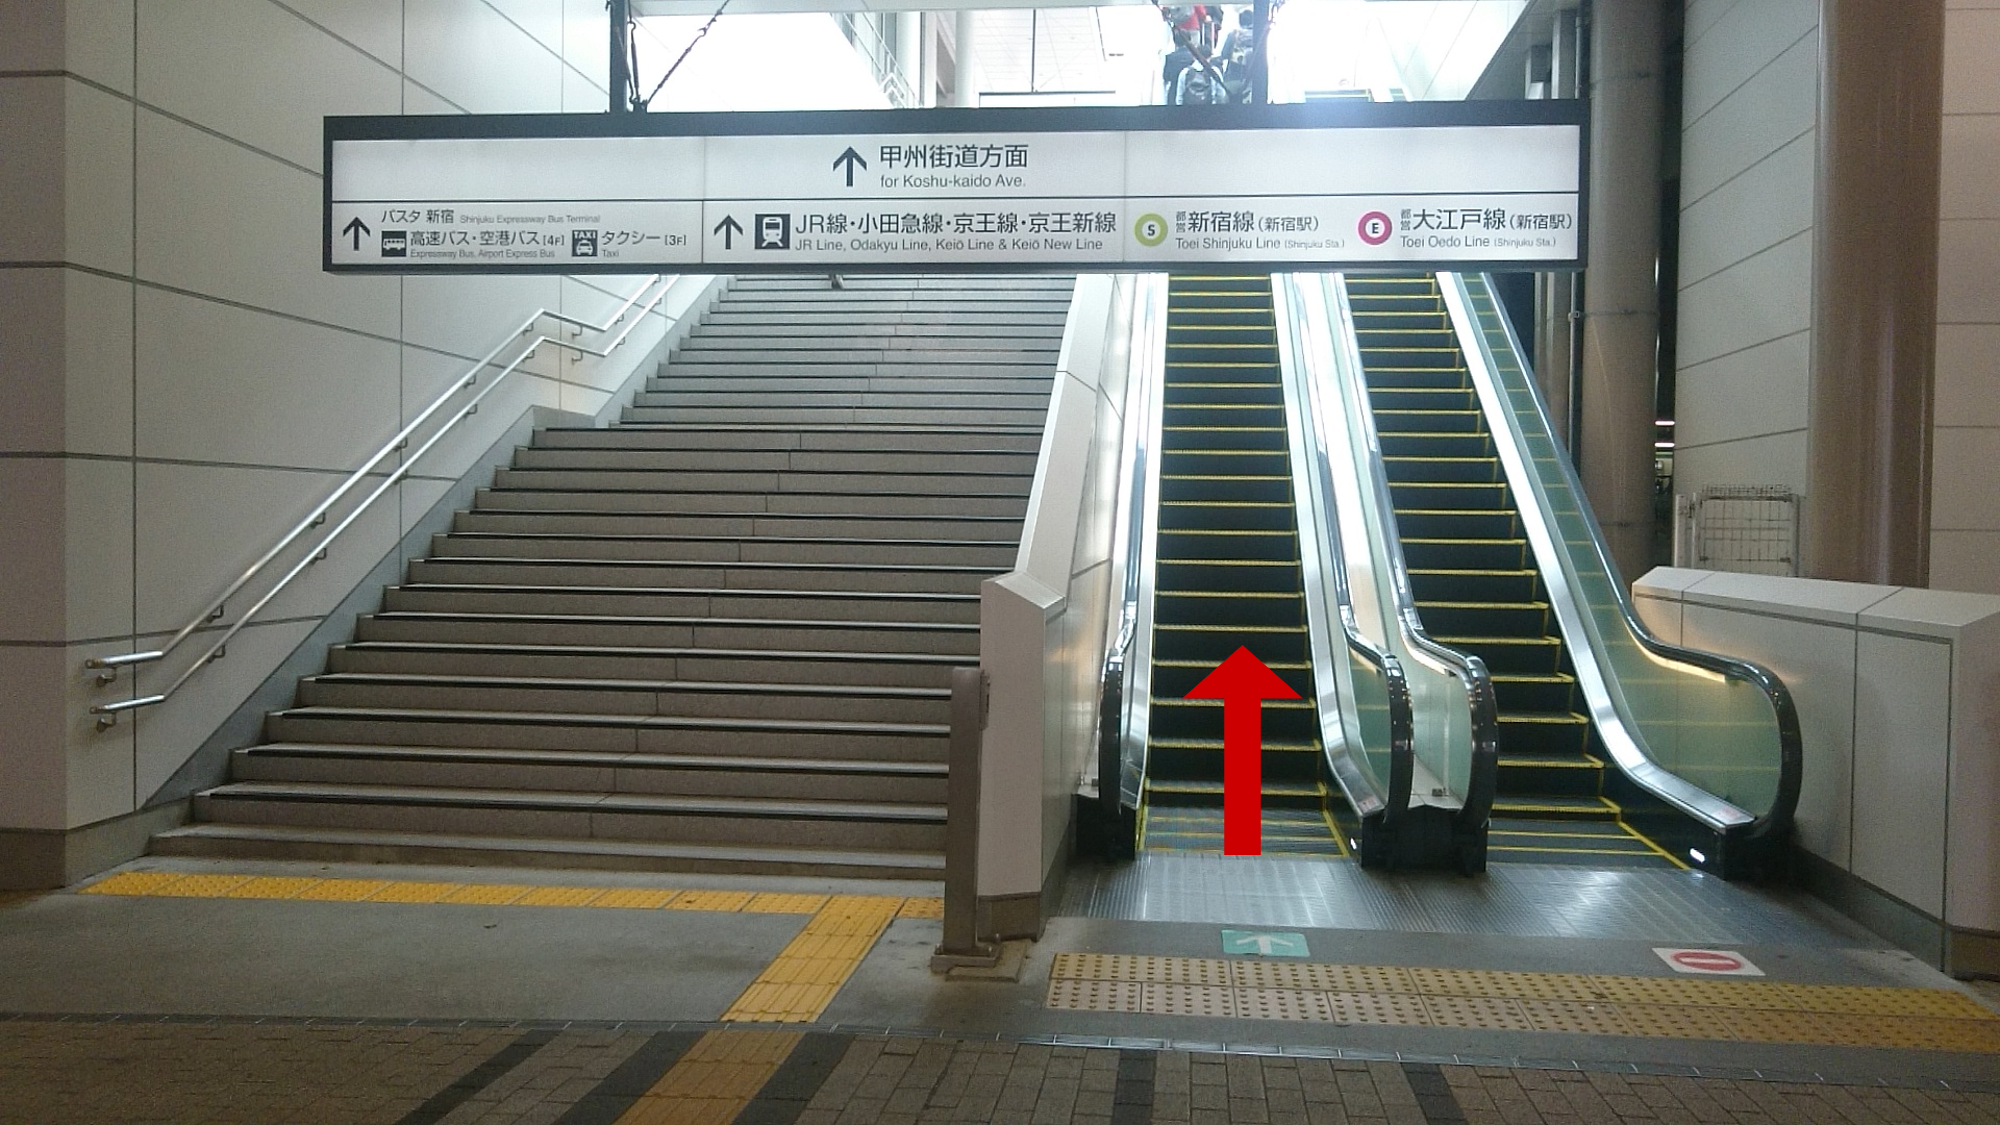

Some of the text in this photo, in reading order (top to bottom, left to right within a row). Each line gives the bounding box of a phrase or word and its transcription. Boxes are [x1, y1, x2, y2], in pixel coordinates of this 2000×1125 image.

[880, 144, 1029, 169] 甲州街道方面
[880, 173, 1026, 189] for Koshu-kaido Ave.
[381, 208, 455, 224] バスタ 新宿
[460, 214, 600, 226] Shinjuku Expressway Bus Terminal
[573, 231, 597, 240] TAXI
[1371, 223, 1379, 234] E
[795, 239, 813, 251] JR
[817, 239, 847, 252] Line,
[850, 238, 898, 253] Odakyu
[902, 238, 932, 252] Line,
[968, 238, 995, 250] Line
[998, 238, 1008, 250] &
[1044, 237, 1073, 250] New
[1076, 237, 1103, 250] Line
[1175, 238, 1200, 249] Toei
[1202, 237, 1253, 252] Shinjuku
[1256, 237, 1281, 249] Line
[1400, 235, 1556, 249] Toei Oedo Line (Shinjuku Sta.)
[410, 249, 457, 260] Expressway
[478, 249, 504, 260] Airport
[506, 249, 538, 260] Express
[540, 249, 555, 258] Bus
[603, 249, 620, 258] Taxi
